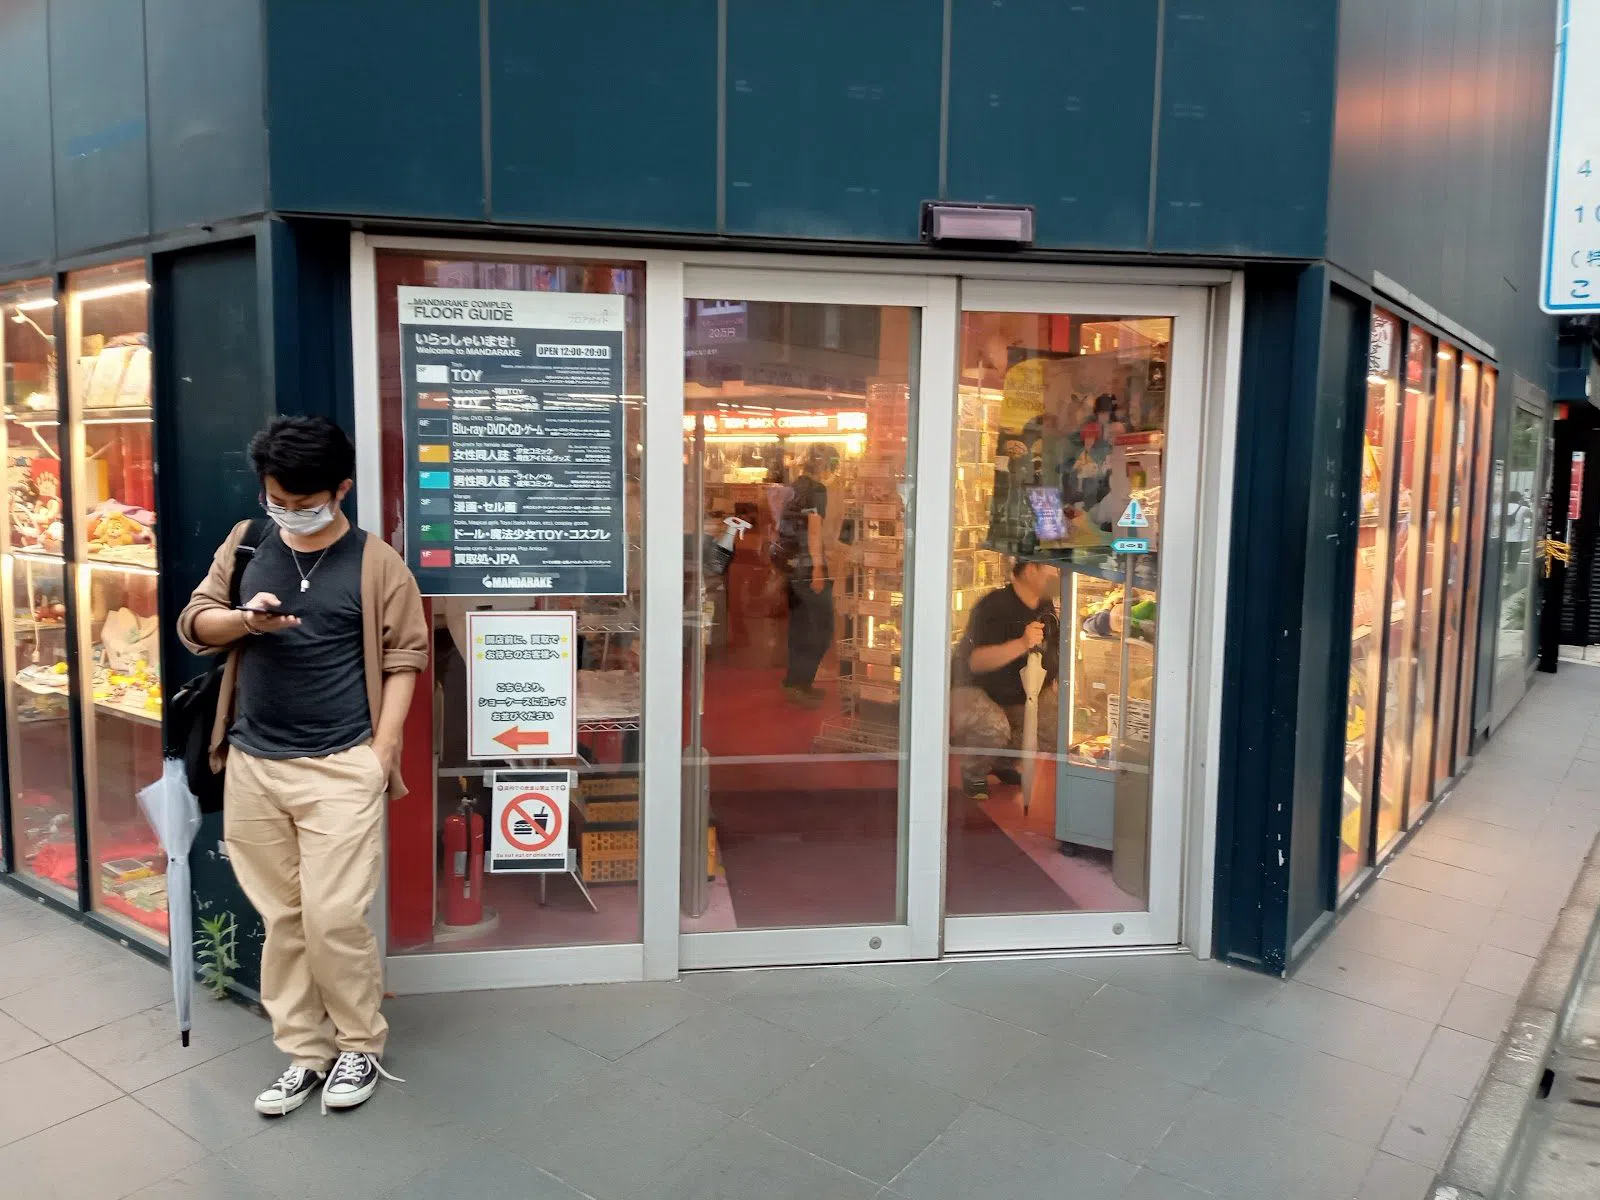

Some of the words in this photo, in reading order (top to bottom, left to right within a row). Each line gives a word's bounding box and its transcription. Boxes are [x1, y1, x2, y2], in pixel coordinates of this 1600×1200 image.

[413, 298, 468, 307] MANDARAKE
[470, 301, 513, 309] COMPLEX
[414, 306, 464, 319] FLOOR
[468, 308, 513, 321] GUIDE
[416, 346, 454, 354] Welcome
[466, 348, 521, 357] MANDARAKE
[538, 347, 559, 356] OPEN
[561, 347, 608, 357] 12:00-20:00
[451, 369, 483, 381] TOY
[492, 577, 553, 588] MANDARAKE
